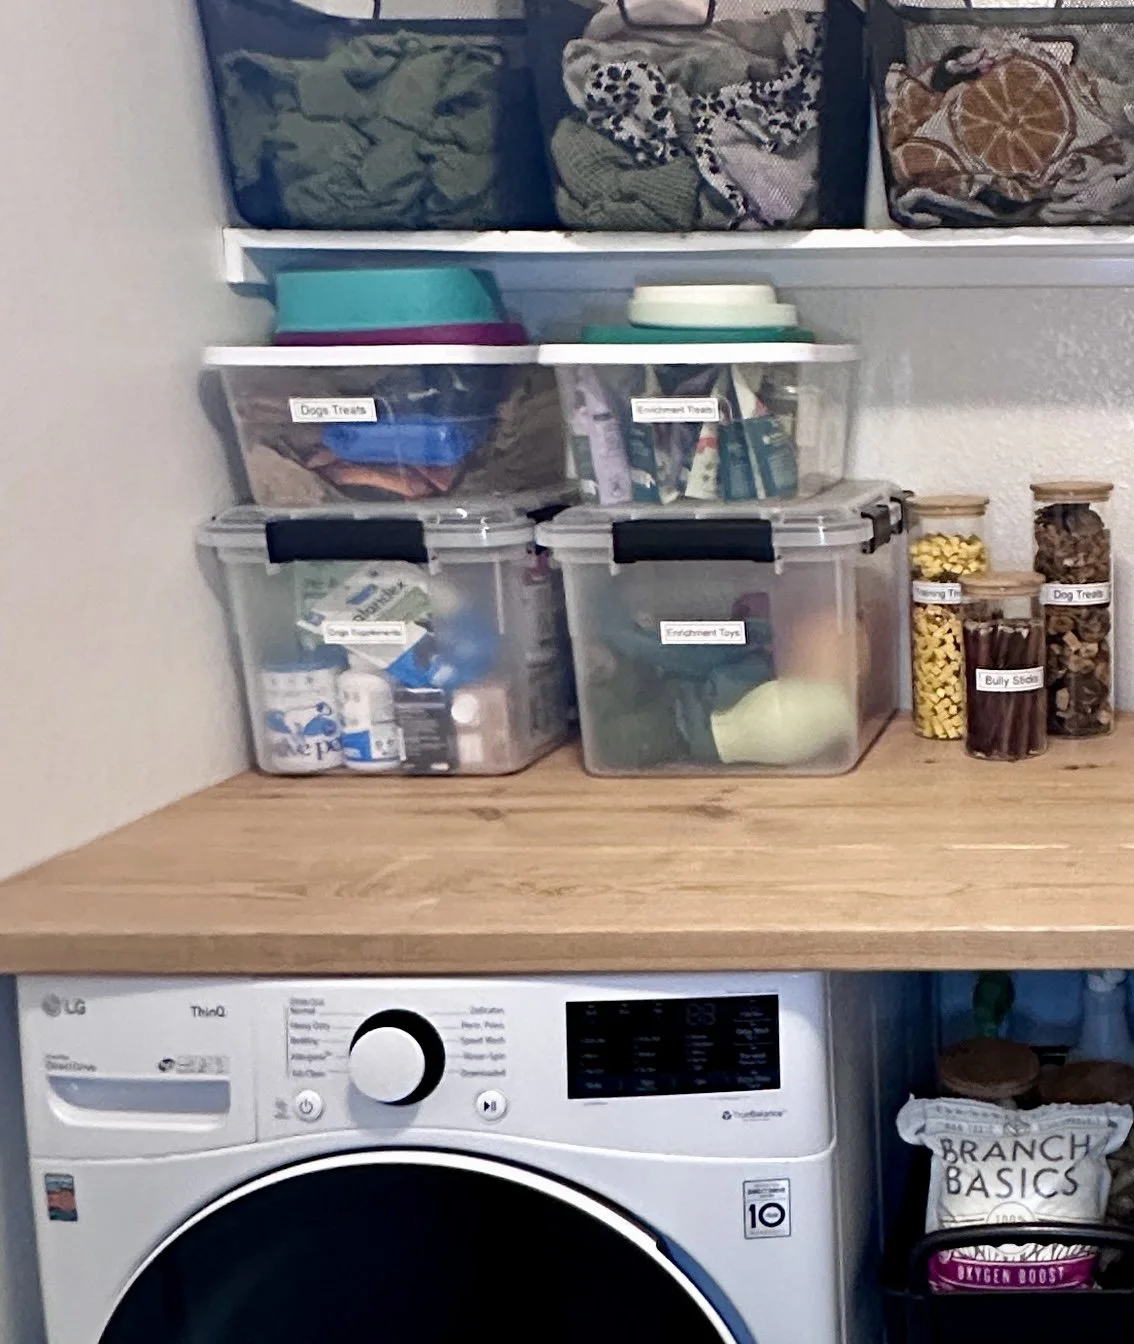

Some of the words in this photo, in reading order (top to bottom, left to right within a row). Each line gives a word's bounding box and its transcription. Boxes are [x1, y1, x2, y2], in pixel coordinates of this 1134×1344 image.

[332, 404, 367, 415] Treats
[1053, 589, 1074, 601] Dog
[1076, 588, 1105, 599] Treats
[666, 627, 717, 637] Enrichment
[719, 627, 741, 639] Toys
[985, 675, 1010, 688] Bully
[1013, 674, 1039, 685] Sticks
[64, 998, 87, 1015] LG
[190, 1005, 226, 1018] ThinQ
[940, 1133, 1091, 1164] BRANCH
[946, 1165, 1079, 1199] BASICS
[749, 1202, 786, 1229] 10
[957, 1265, 1011, 1284] OXYGEN
[1018, 1265, 1065, 1284] BOOST
